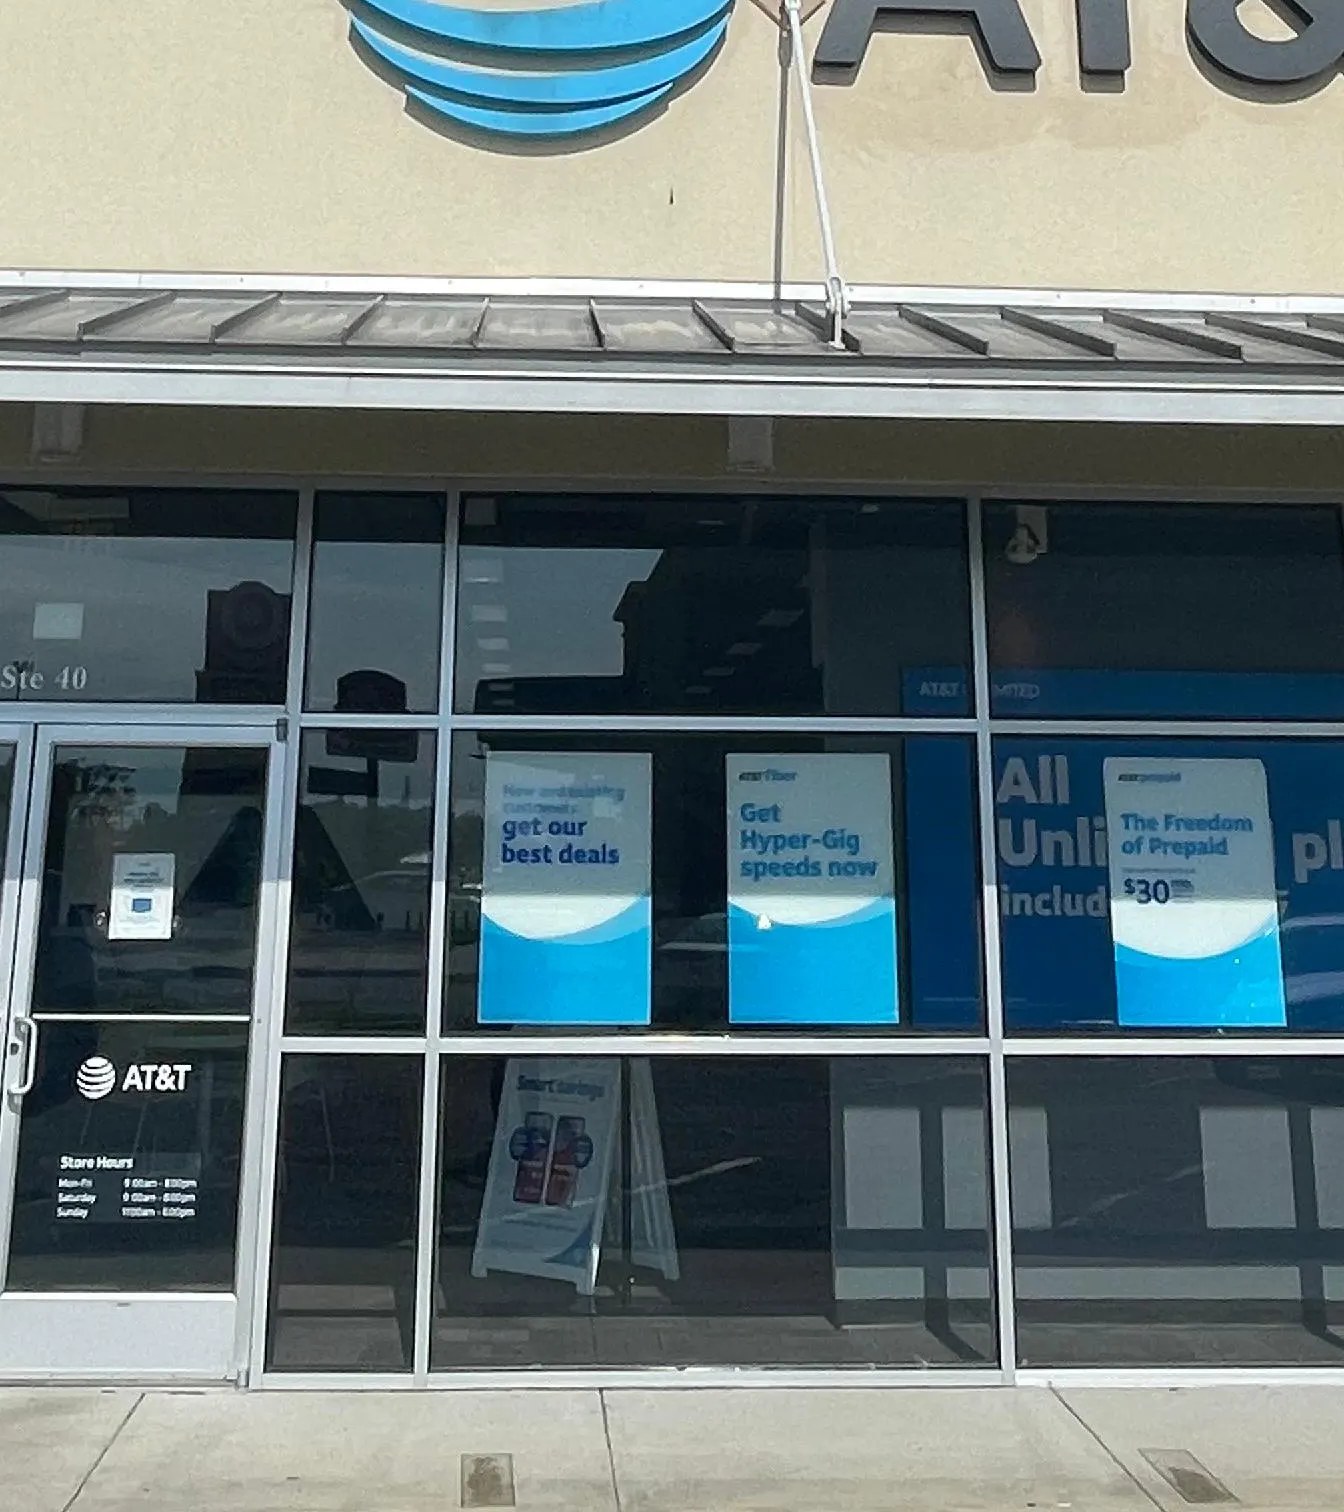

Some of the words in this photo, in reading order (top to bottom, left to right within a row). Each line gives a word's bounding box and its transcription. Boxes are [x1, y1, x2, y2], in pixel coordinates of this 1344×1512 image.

[0, 665, 44, 690] Ste
[53, 665, 88, 690] 40
[997, 754, 1070, 805] All
[740, 802, 781, 823] Get
[1120, 812, 1160, 831] The
[1163, 812, 1254, 832] Freedom
[502, 817, 543, 841] get
[548, 820, 588, 836] our
[501, 842, 553, 864] best
[558, 842, 620, 864] deals
[740, 828, 860, 856] Hyper-Gig
[1121, 835, 1143, 854] of
[1149, 835, 1229, 860] Prepaid
[740, 855, 822, 882] speeds
[828, 861, 878, 877] now
[1124, 878, 1170, 904] $30
[121, 1064, 192, 1092] AT&T
[59, 1155, 95, 1170] Store
[96, 1155, 134, 1170] Hours
